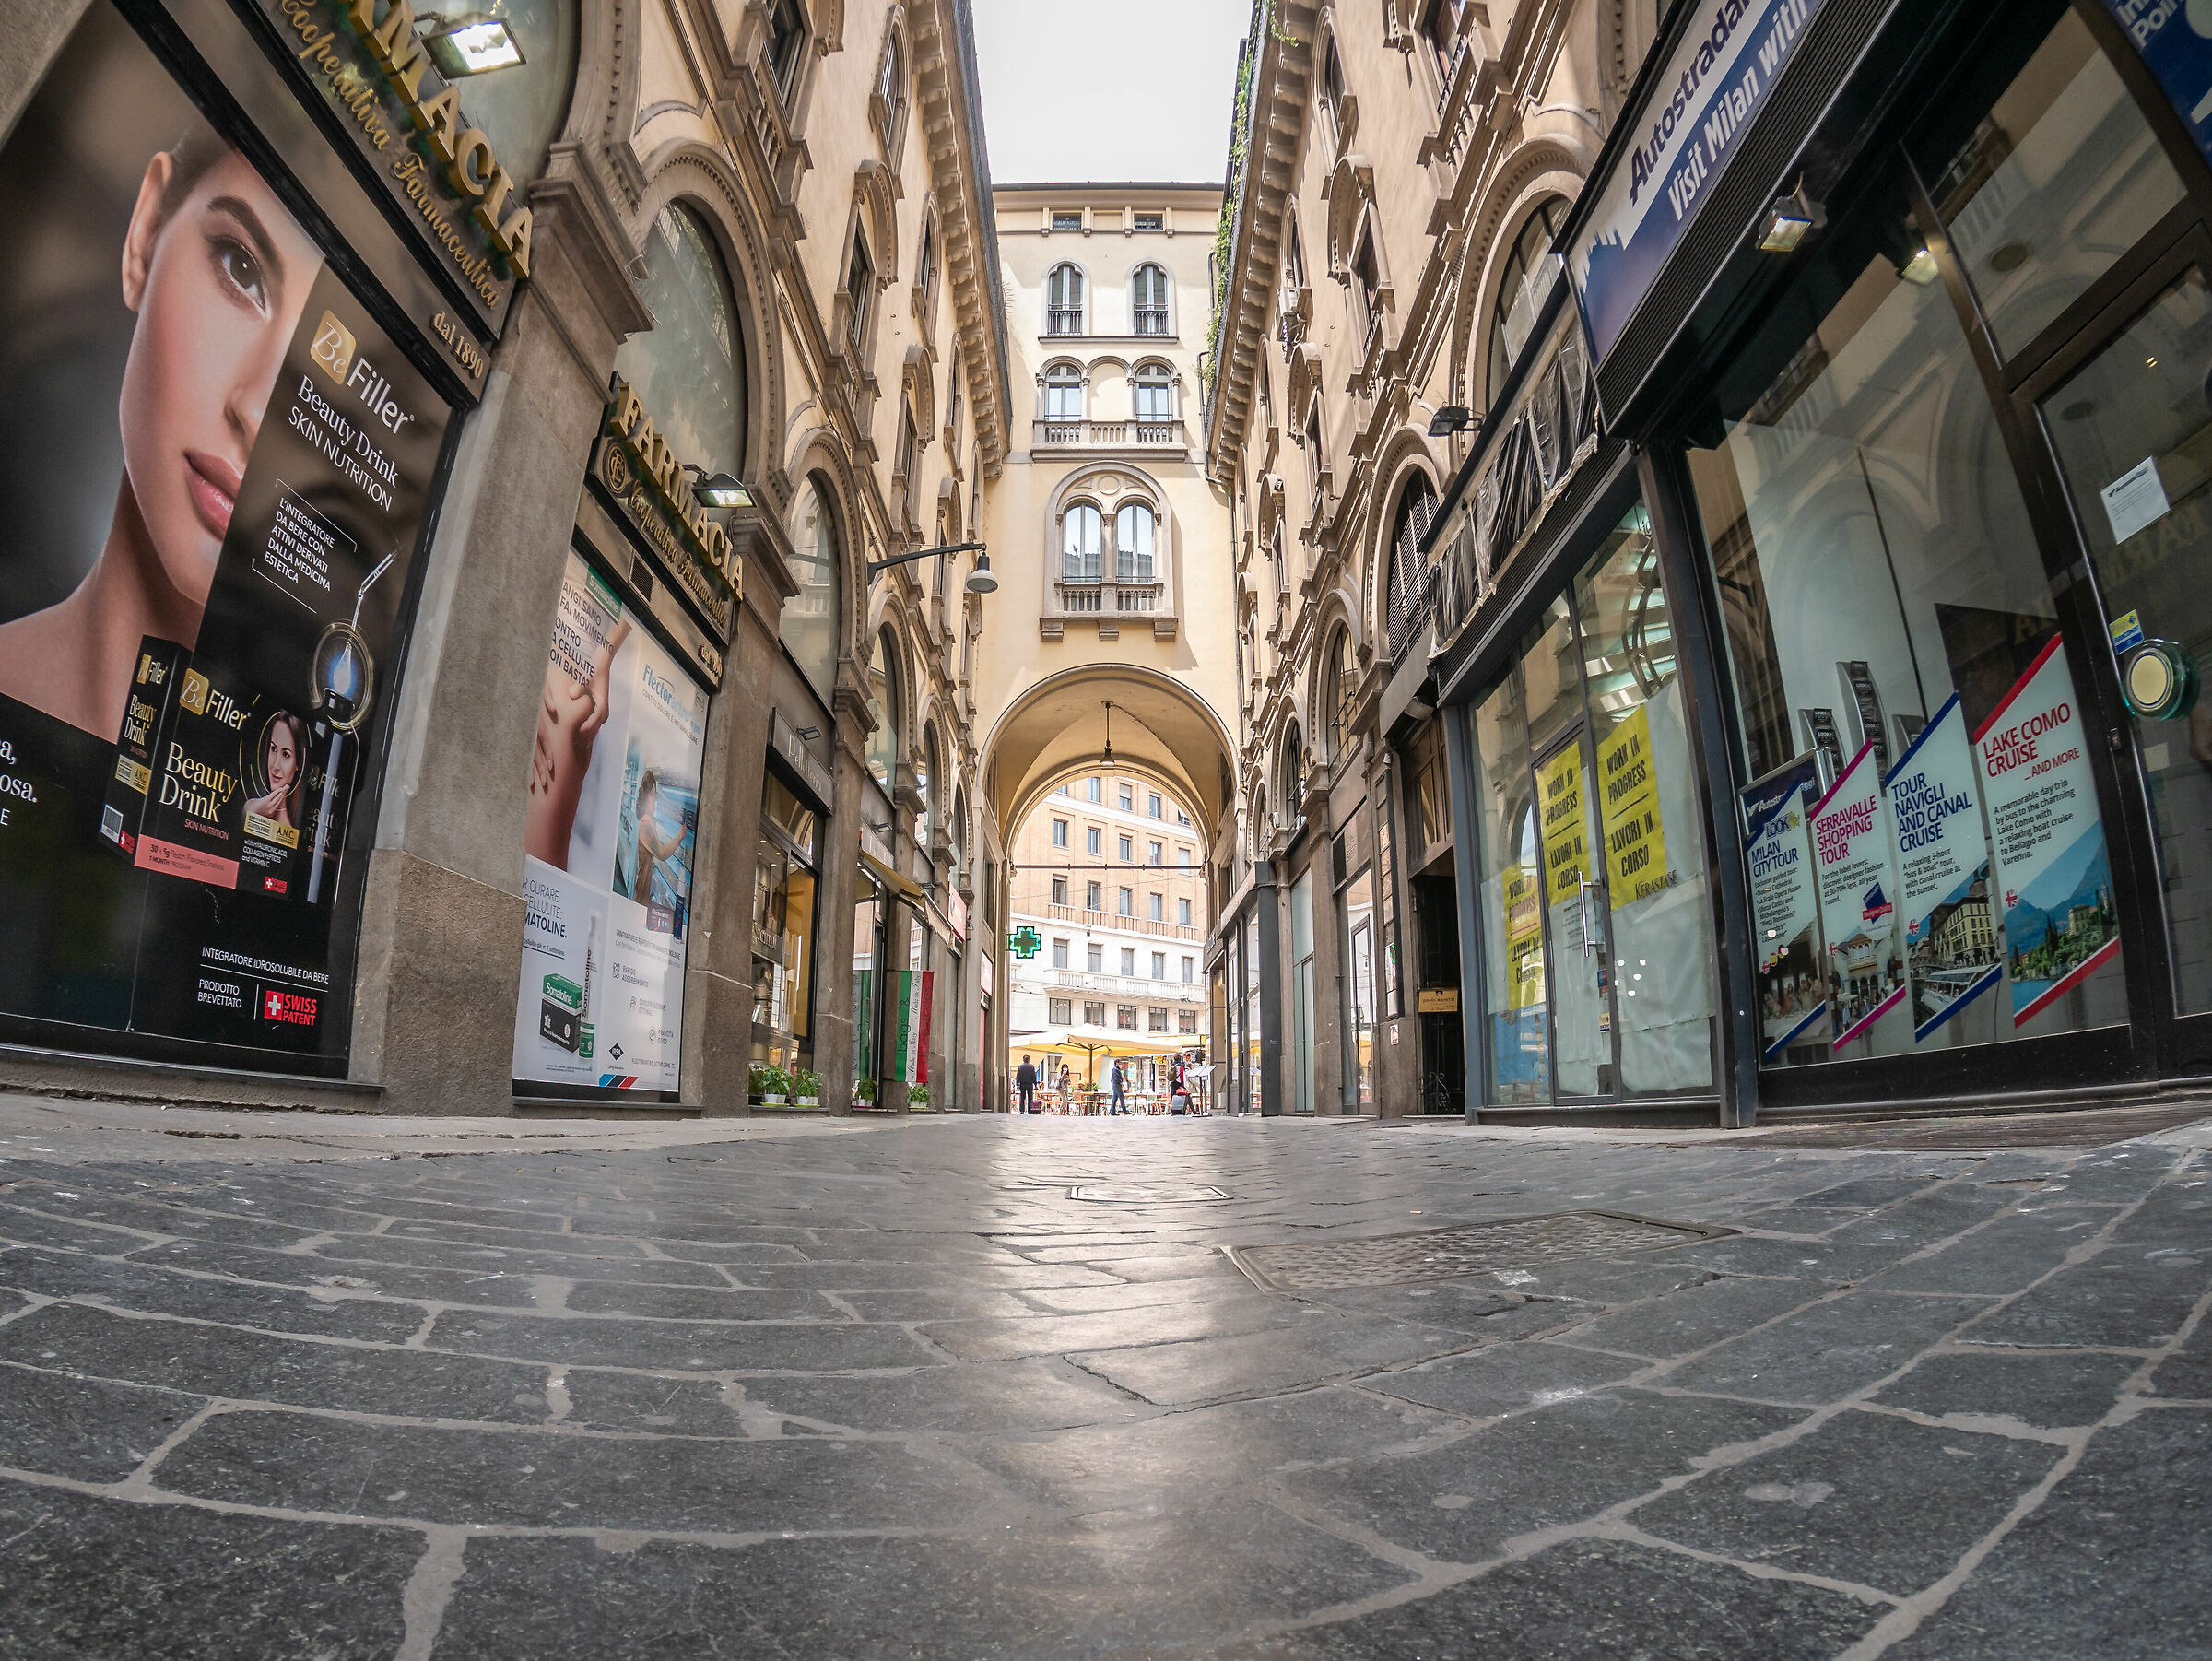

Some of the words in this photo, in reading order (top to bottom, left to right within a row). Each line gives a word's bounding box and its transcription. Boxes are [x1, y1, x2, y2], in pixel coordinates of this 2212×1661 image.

[1668, 140, 1708, 221] Visit
[1704, 65, 1759, 162] Milan
[394, 152, 500, 311] Farmaceutica
[433, 311, 457, 345] dal
[454, 335, 484, 379] 1890
[298, 374, 357, 446] Beauty
[355, 430, 399, 489] Drink
[288, 406, 324, 448] SKIN
[323, 438, 393, 512] NUTRITION
[610, 382, 744, 601] FARMACIA
[271, 524, 296, 548] ATTIVI
[296, 544, 329, 574] DERIVATI
[276, 511, 288, 527] DA
[288, 521, 309, 544] BERE
[307, 536, 326, 556] CON
[264, 550, 300, 584] ESTETICA
[267, 537, 293, 564] DALLA
[294, 557, 331, 592] MEDICINA
[559, 595, 572, 616] FAI
[572, 610, 614, 655] MOVIMENTO
[582, 600, 602, 627] SANO
[559, 638, 594, 677] CELLULITE
[563, 660, 591, 690] BASTA?
[129, 694, 157, 730] Beauty
[124, 717, 147, 746] Drink
[1983, 726, 2020, 760] LAKE
[2021, 702, 2071, 740] COMO
[165, 741, 238, 803] Beauty
[1606, 743, 1629, 776] WORK
[1630, 734, 1641, 758] IN
[1987, 739, 2039, 778] CRUISE
[2052, 747, 2080, 768] MORE
[159, 773, 222, 823] Drink
[1547, 772, 1565, 801] WORK
[1567, 766, 1574, 784] IN
[1607, 760, 1647, 805] PROGRESS
[1891, 772, 1927, 801] TOUR
[1994, 806, 2000, 815] A
[2000, 788, 2039, 812] memorable
[2040, 784, 2053, 797] day
[2054, 779, 2068, 792] trip
[1546, 790, 1578, 827] PROGRESS
[1816, 795, 1877, 836] SERRAVALLE
[1895, 783, 1945, 819] NAVIGLI
[1898, 811, 1925, 836] AND
[1927, 792, 1972, 823] CANAL
[1995, 816, 2005, 826] by
[2005, 811, 2018, 822] bus
[2018, 808, 2027, 817] to
[2027, 803, 2040, 814] the
[2040, 788, 2076, 808] charming
[1611, 818, 1641, 854] LAVORI
[1643, 810, 1654, 835] IN
[1818, 815, 1873, 851] SHOPPING
[1900, 821, 1944, 853] CRUISE
[1997, 822, 2014, 836] Lake
[2014, 817, 2034, 830] Como
[2035, 807, 2053, 821] with
[2005, 828, 2033, 845] relaxing
[2033, 820, 2051, 834] boat
[2051, 812, 2074, 827] cruise
[150, 844, 159, 854] 30
[1549, 842, 1572, 869] LAVORI
[1573, 835, 1583, 855] IN
[1751, 839, 1781, 865] MILAN
[1819, 842, 1851, 866] TOUR
[1908, 854, 1932, 869] relaxing
[1932, 848, 1951, 860] 3-hour
[2000, 847, 2008, 856] to
[2009, 836, 2037, 854] Bellagio
[2037, 830, 2052, 842] and
[2002, 850, 2033, 866] Varenna.
[1557, 864, 1580, 891] CORSO
[1620, 844, 1650, 878] CORSO
[1753, 858, 1771, 878] CITY
[1773, 848, 1799, 870] TOUR
[1821, 871, 1830, 881] For
[1830, 869, 1839, 878] the
[1842, 870, 1864, 886] designer
[1864, 862, 1885, 877] fashion
[1905, 878, 1919, 889] with
[1919, 871, 1935, 885] canal
[1936, 866, 1957, 879] cruise
[529, 879, 559, 903] CURARE
[1865, 873, 1878, 885] year
[1906, 889, 1917, 899] the
[202, 947, 253, 968] INTEGRATORE
[253, 958, 301, 979] IDROSOLUBILE
[302, 970, 312, 981] DA
[313, 972, 330, 984] BERE
[197, 992, 242, 1009] BREVETTATO
[198, 979, 240, 995] PRODOTTO
[546, 982, 573, 1006] Somatoline
[282, 1010, 316, 1027] PATENT
[284, 994, 318, 1015] SWISS
[900, 1019, 912, 1052] bags
